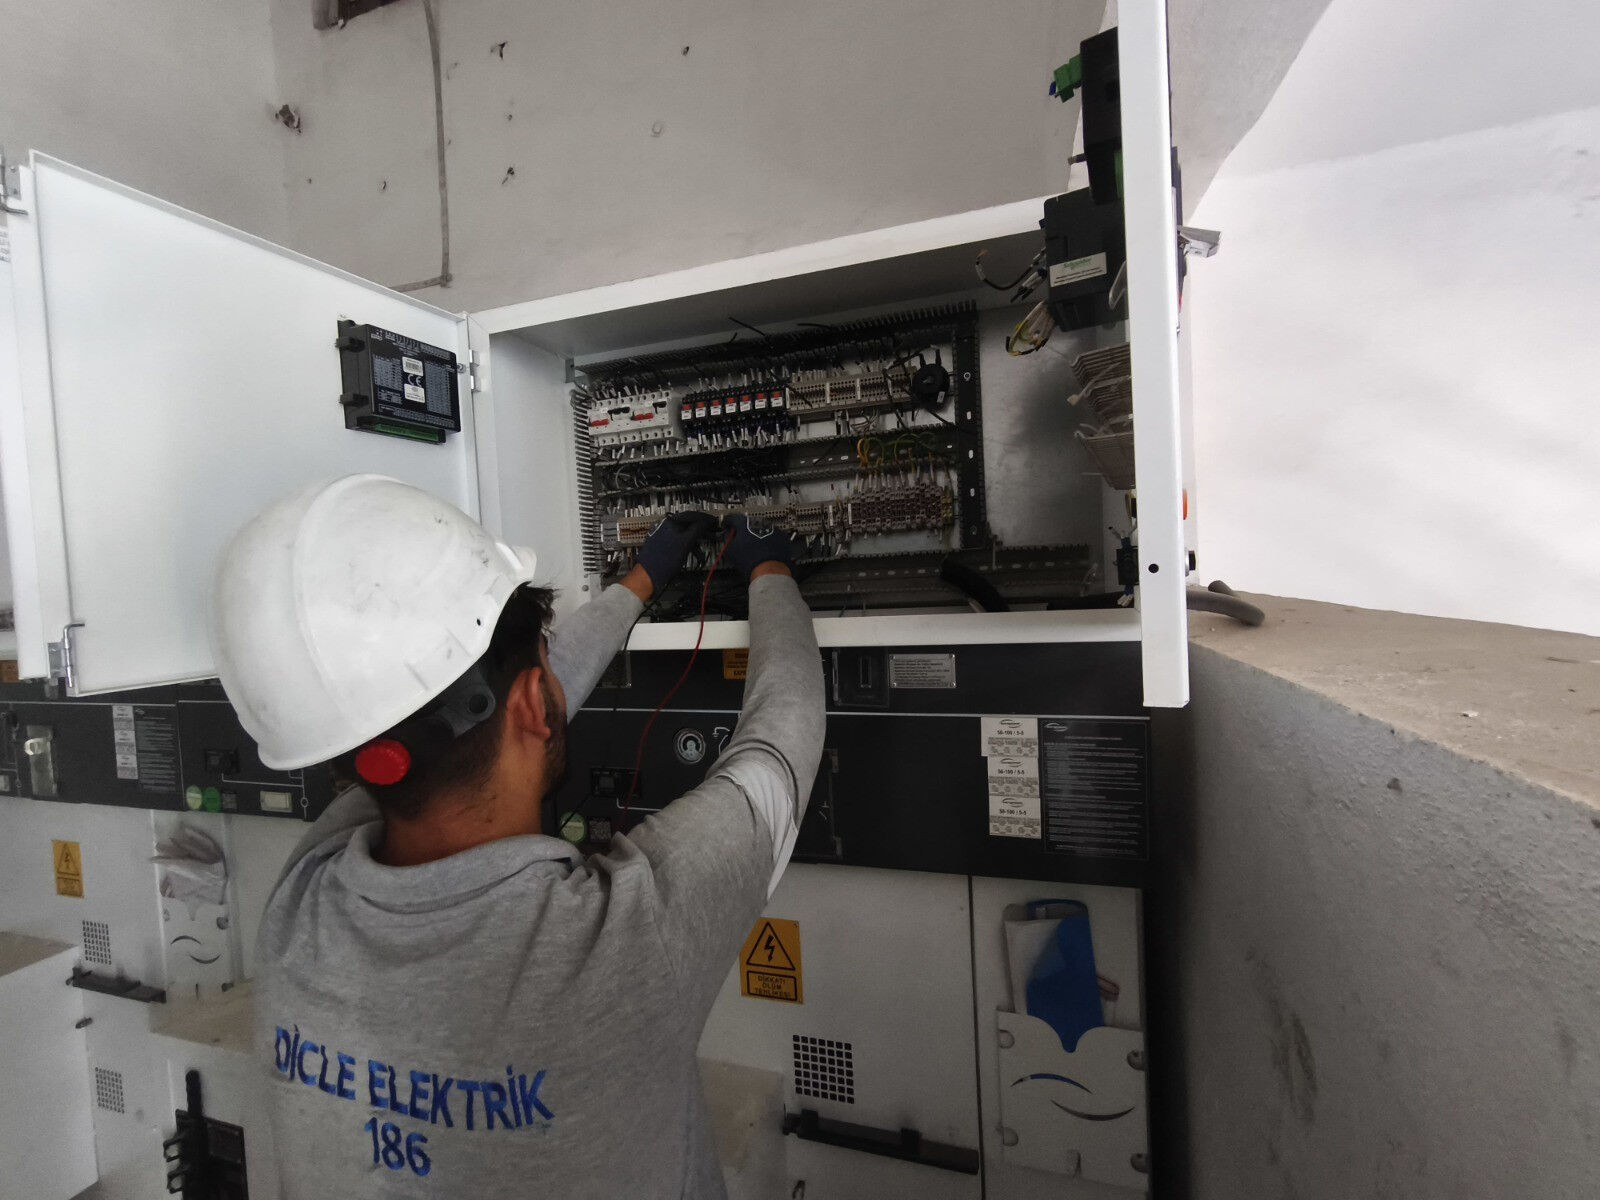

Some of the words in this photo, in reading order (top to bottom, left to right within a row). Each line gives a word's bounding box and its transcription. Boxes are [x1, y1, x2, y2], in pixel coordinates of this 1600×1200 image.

[275, 1023, 356, 1100] DİCLE
[368, 1059, 555, 1131] ELEKTRİK
[364, 1116, 432, 1177] 186
